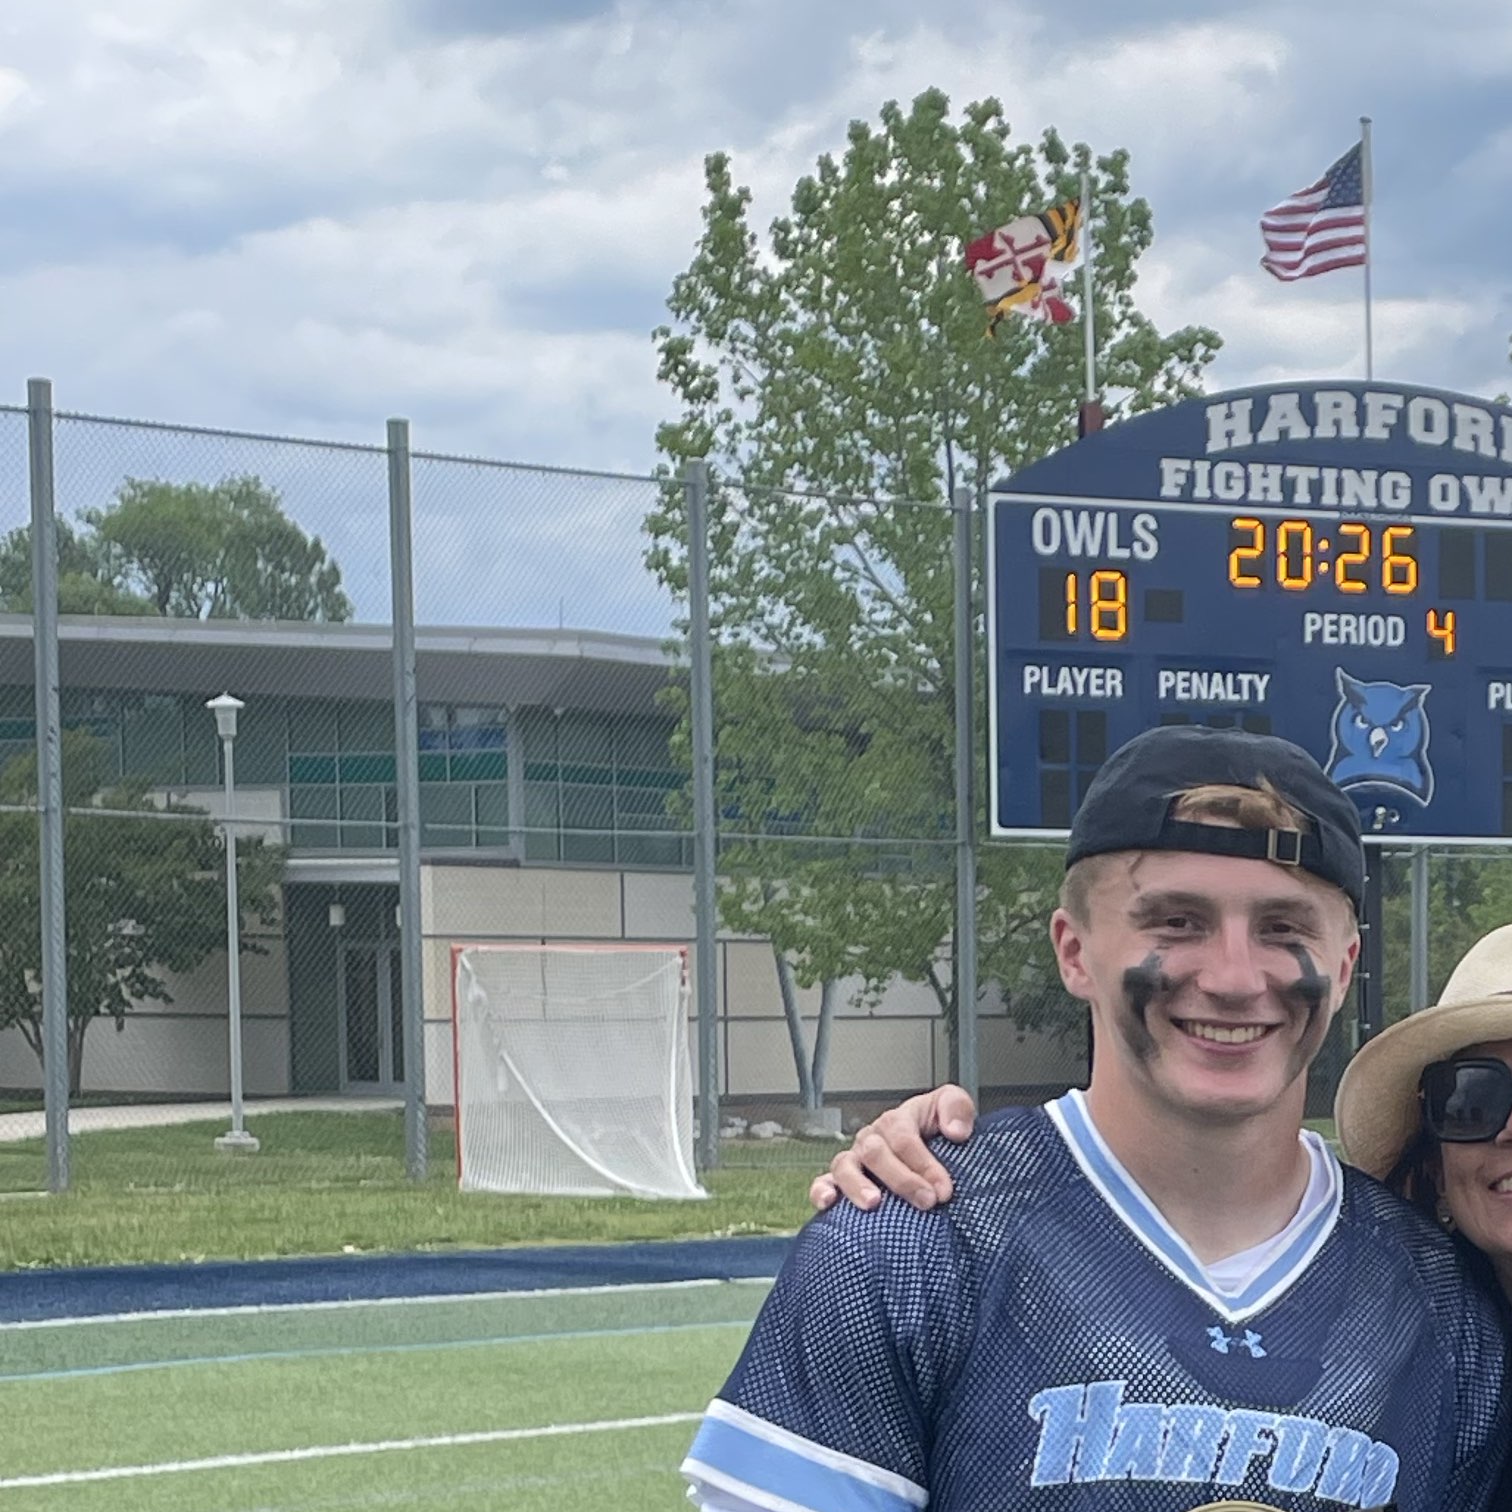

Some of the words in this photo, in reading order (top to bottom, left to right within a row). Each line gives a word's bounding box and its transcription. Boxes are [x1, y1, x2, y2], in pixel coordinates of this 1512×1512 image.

[1160, 457, 1412, 509] FIGHTING
[1032, 507, 1159, 561] OWLS
[1228, 517, 1419, 594] 20:26
[1064, 569, 1128, 642] 18
[1303, 611, 1406, 647] PERIOD
[1425, 608, 1457, 655] 4
[1023, 664, 1124, 699] PLAYER
[1158, 670, 1271, 702] PENALTY
[1027, 1379, 1401, 1509] HARFORD
